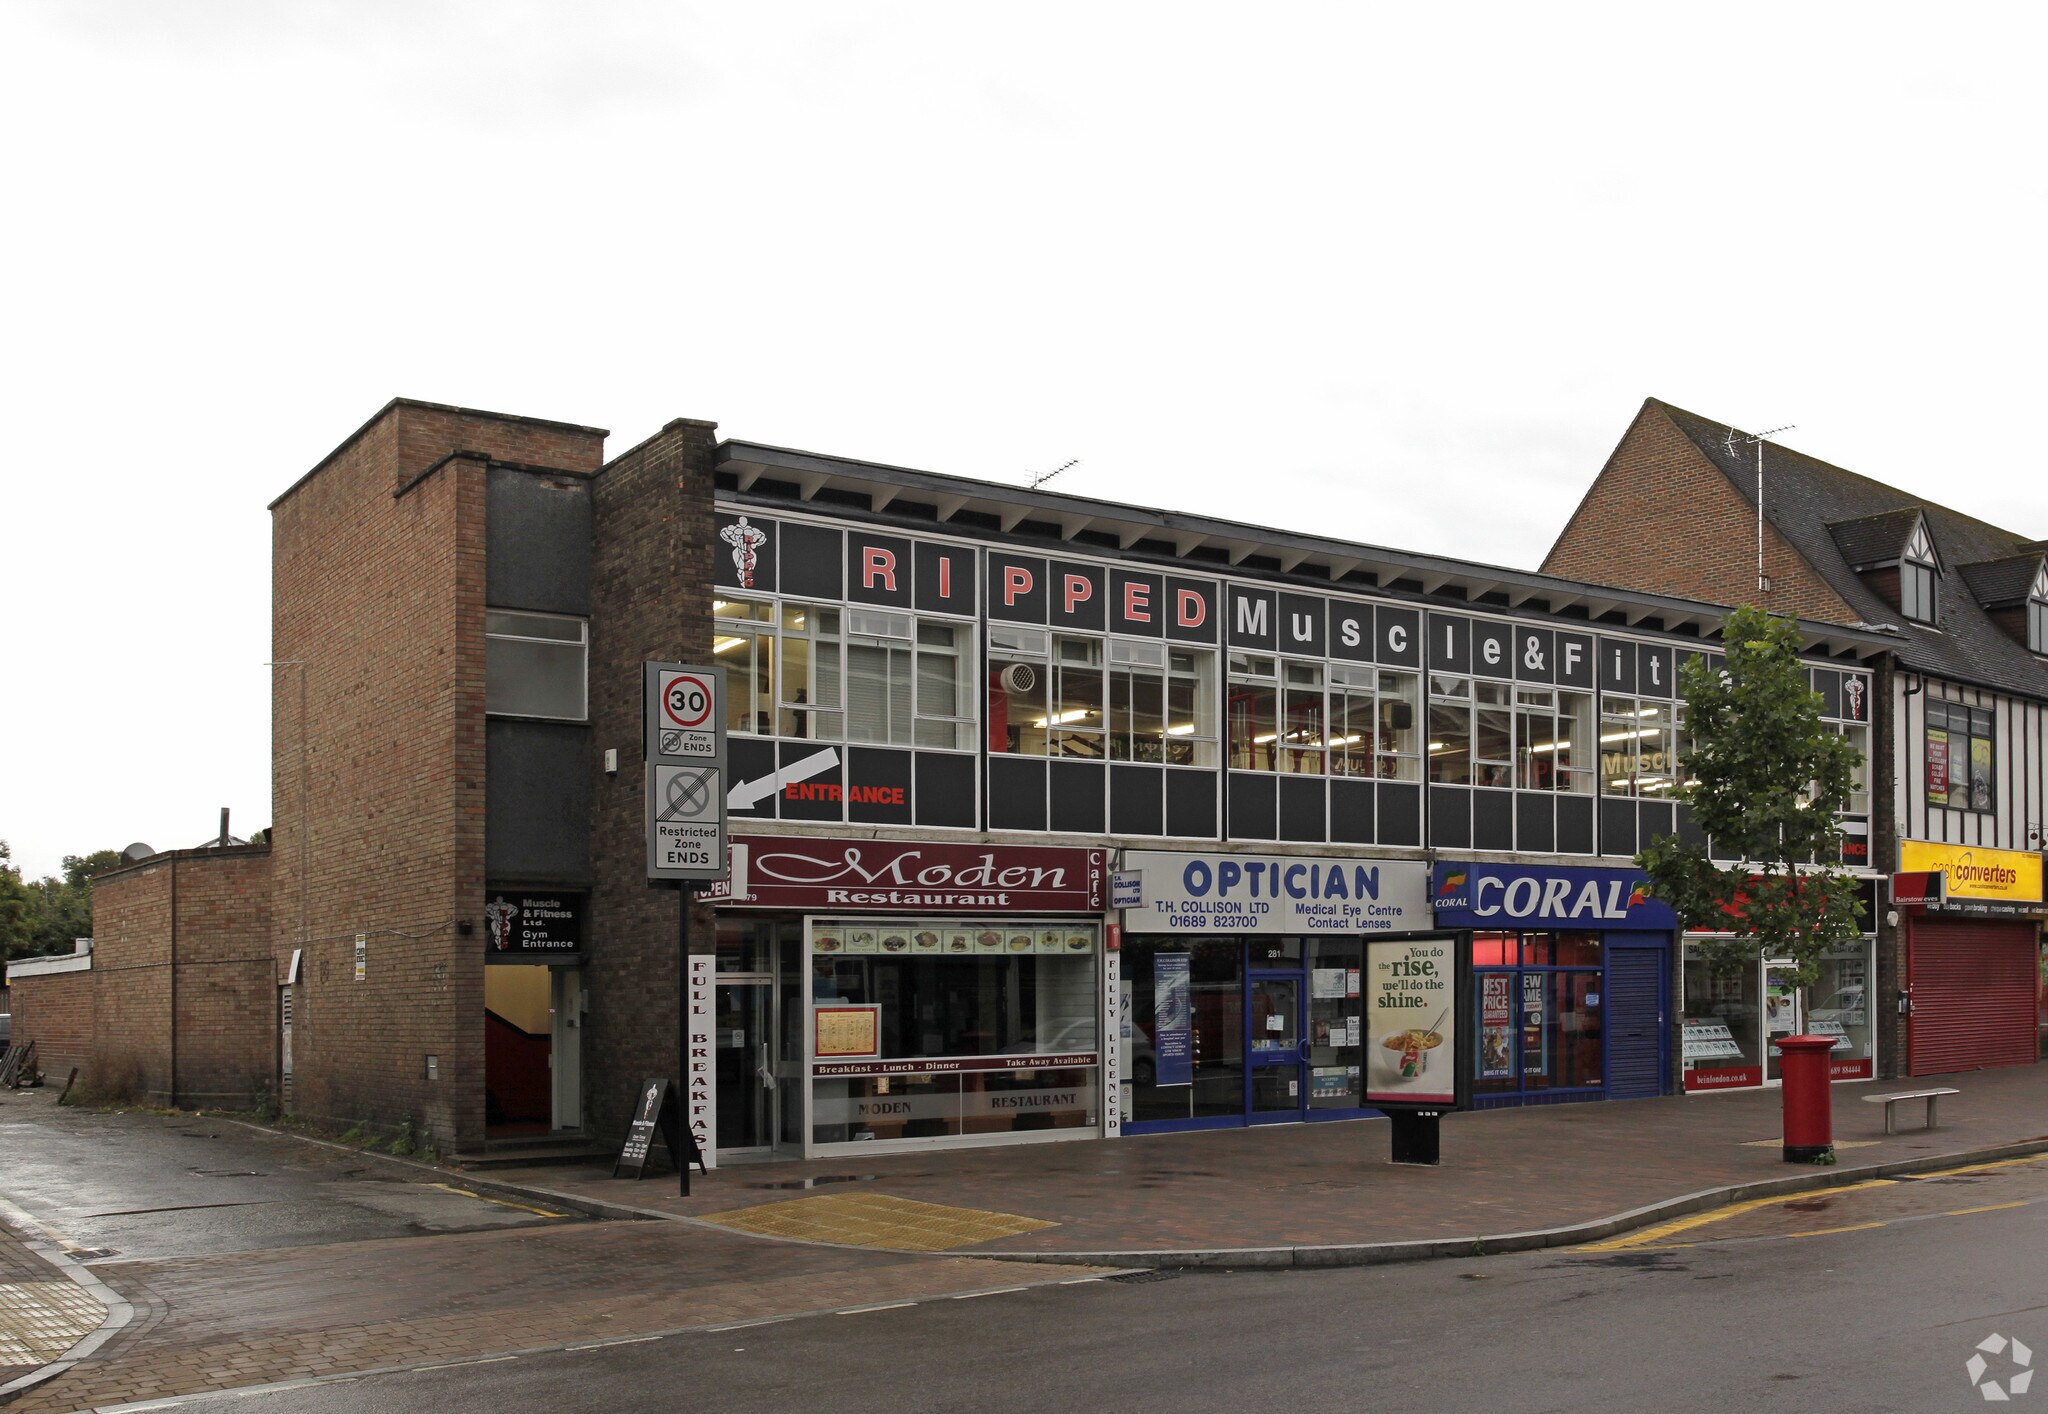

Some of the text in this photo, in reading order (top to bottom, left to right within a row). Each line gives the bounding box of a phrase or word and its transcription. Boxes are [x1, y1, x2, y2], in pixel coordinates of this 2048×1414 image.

[863, 546, 1206, 628] RIPPED
[1237, 596, 1501, 665] Muscle
[1524, 636, 1545, 670] &
[670, 690, 705, 712] 30
[664, 737, 679, 747] 20
[689, 734, 707, 742] Zone
[683, 742, 712, 752] ENDS
[785, 782, 904, 805] ENTRANCE
[659, 826, 716, 838] Restricted
[674, 839, 701, 849] Zone
[1842, 843, 1867, 856] ANCE
[667, 852, 709, 864] ENDS
[756, 848, 1067, 888] Moden
[1089, 852, 1100, 908] Café
[1183, 860, 1379, 900] OPTICIAN
[523, 899, 560, 907] Muscle
[826, 890, 1010, 906] Restaurant
[1435, 898, 1468, 908] CORAL
[1473, 876, 1628, 919] CORAL
[523, 910, 572, 918] & Fitness
[1155, 901, 1270, 914] T.H. COLLISON LTD
[1295, 903, 1403, 918] Medical Eye Centre
[1170, 915, 1258, 928] 01689 823700
[1308, 917, 1391, 929] Contact Lenses
[522, 930, 548, 940] Gym
[523, 940, 573, 948] Entrance
[1268, 950, 1280, 958] 281
[1410, 947, 1444, 958] You do
[1391, 955, 1439, 979] rise,
[1382, 979, 1444, 991] we'll do the
[1483, 978, 1508, 995] BEST
[1523, 975, 1541, 988] EW
[692, 962, 707, 1015] FULL
[1523, 988, 1542, 1002] AME
[1378, 992, 1428, 1008] shine.
[1483, 995, 1508, 1010] PRICE
[1483, 1010, 1508, 1020] GUARANTEED
[1108, 960, 1118, 1129] FULLY LICENCED
[819, 1062, 960, 1074] Breakfast Lunch Dinner
[1006, 1056, 1091, 1067] Take Away Available
[1830, 1066, 1840, 1074] 689
[858, 1093, 1077, 1116] MODEN RESTAURANT
